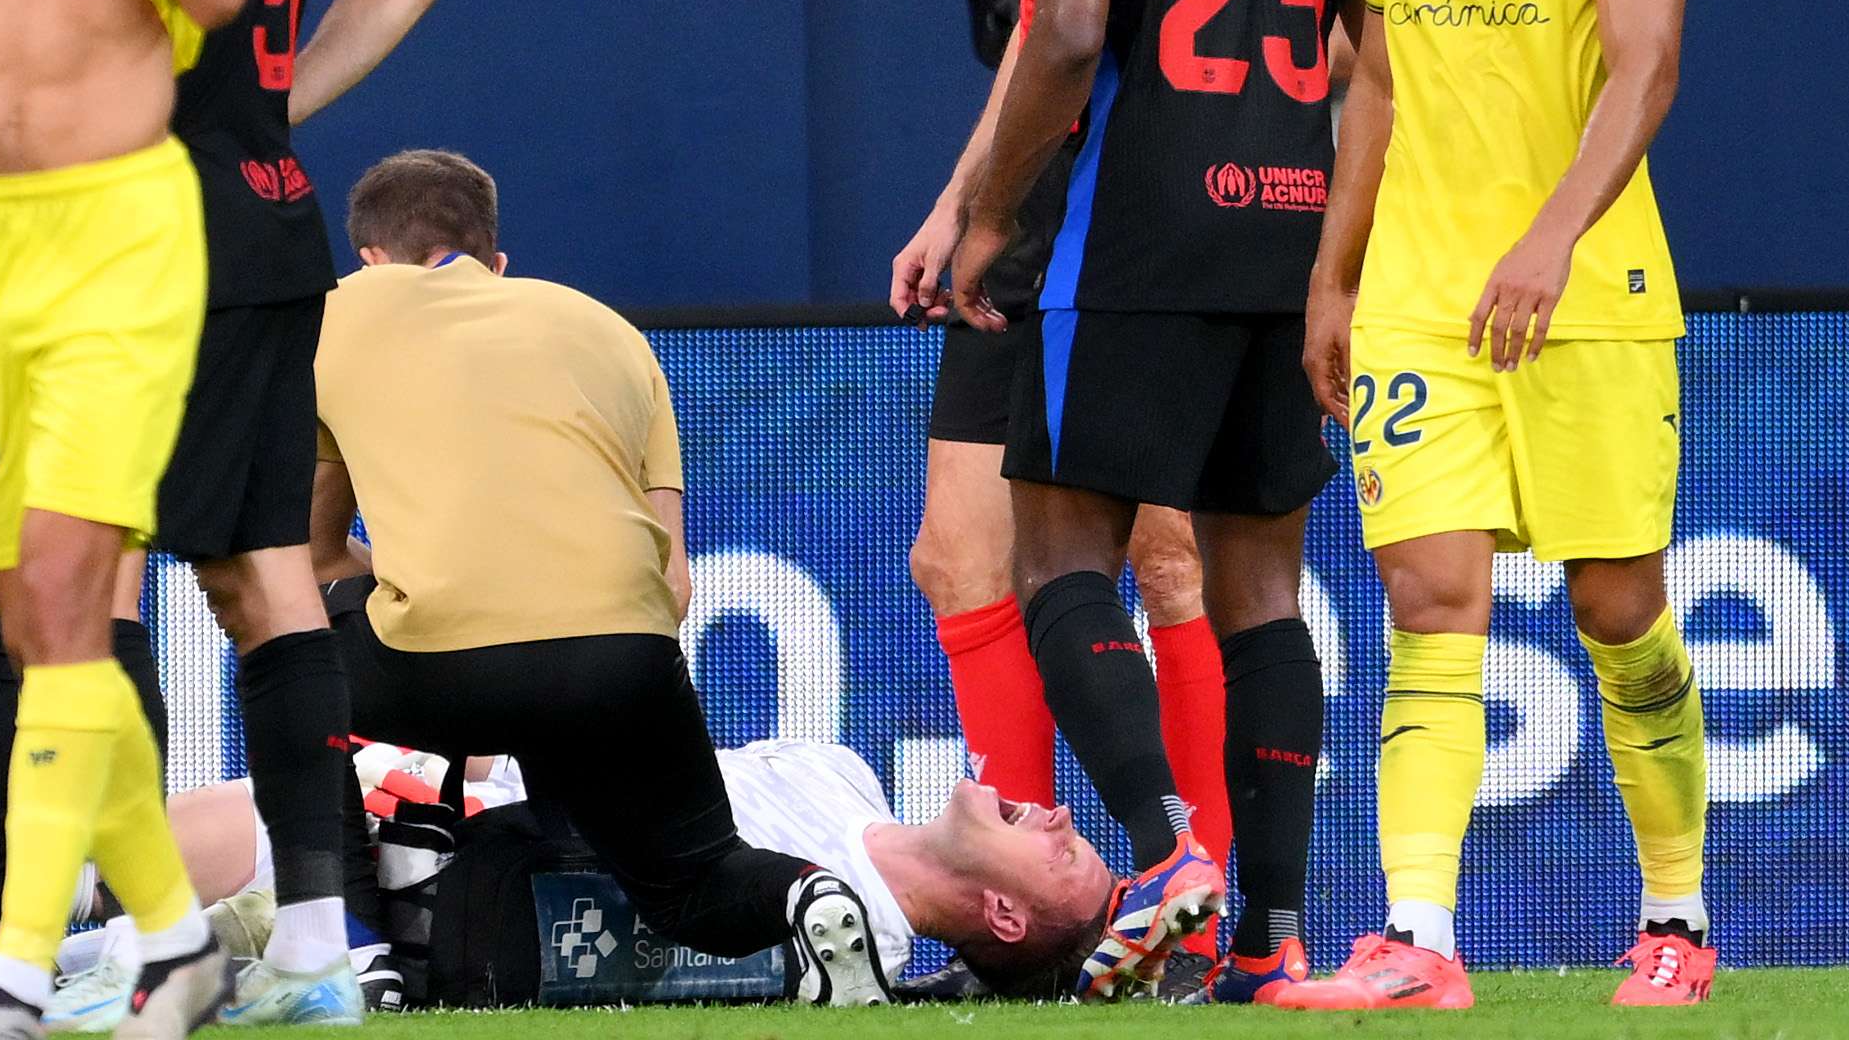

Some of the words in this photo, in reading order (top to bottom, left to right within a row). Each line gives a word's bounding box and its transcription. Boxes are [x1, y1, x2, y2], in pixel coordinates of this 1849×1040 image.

[1258, 166, 1326, 188] UNHCR
[1261, 185, 1328, 204] ACNUR
[1353, 371, 1429, 453] 22
